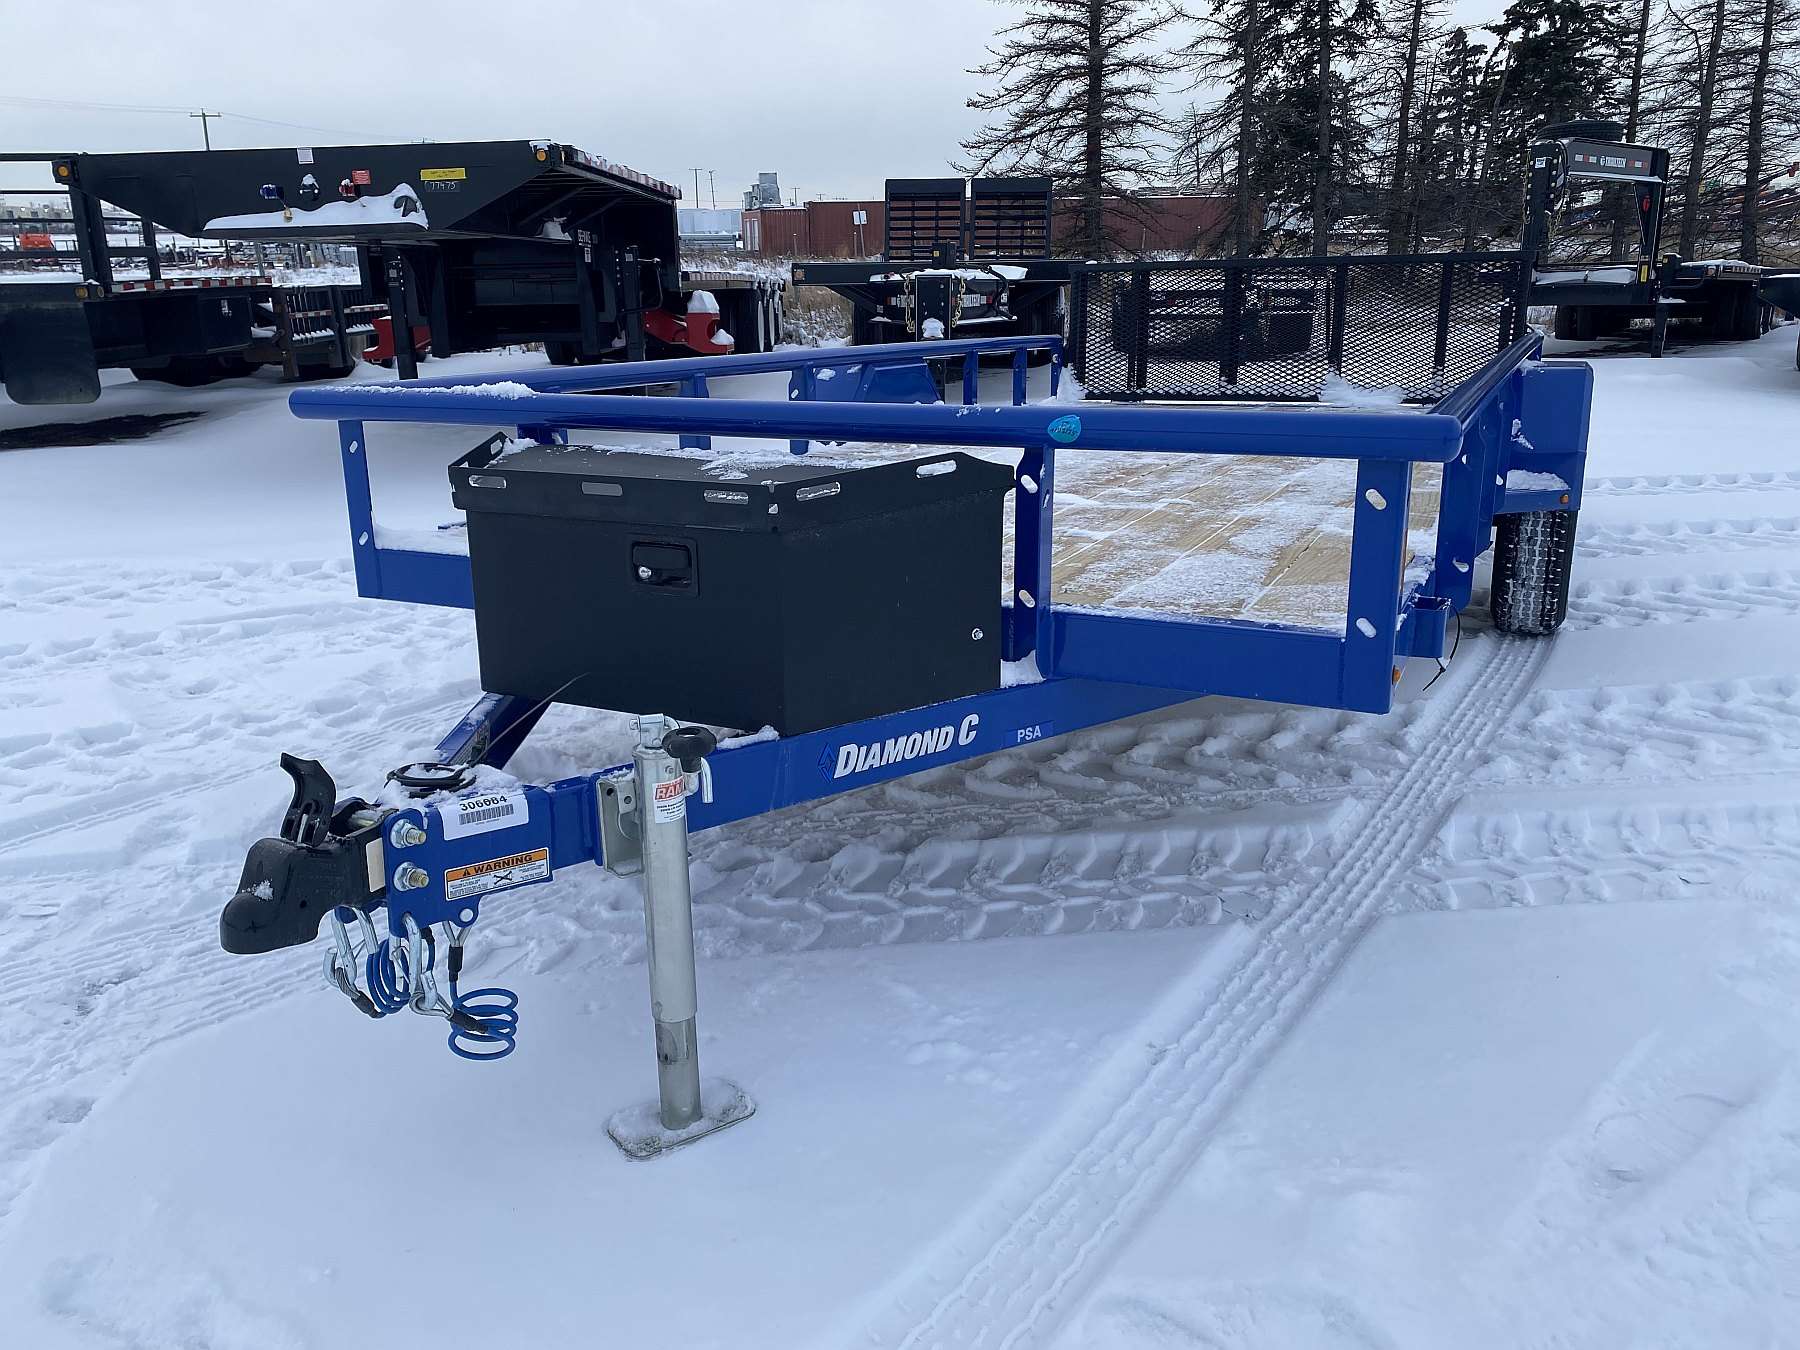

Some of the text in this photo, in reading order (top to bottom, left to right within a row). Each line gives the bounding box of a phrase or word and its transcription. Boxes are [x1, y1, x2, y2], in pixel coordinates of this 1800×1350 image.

[1017, 725, 1042, 743] PSA
[833, 713, 980, 779] DIAMOND C
[473, 854, 533, 874] WARNING
